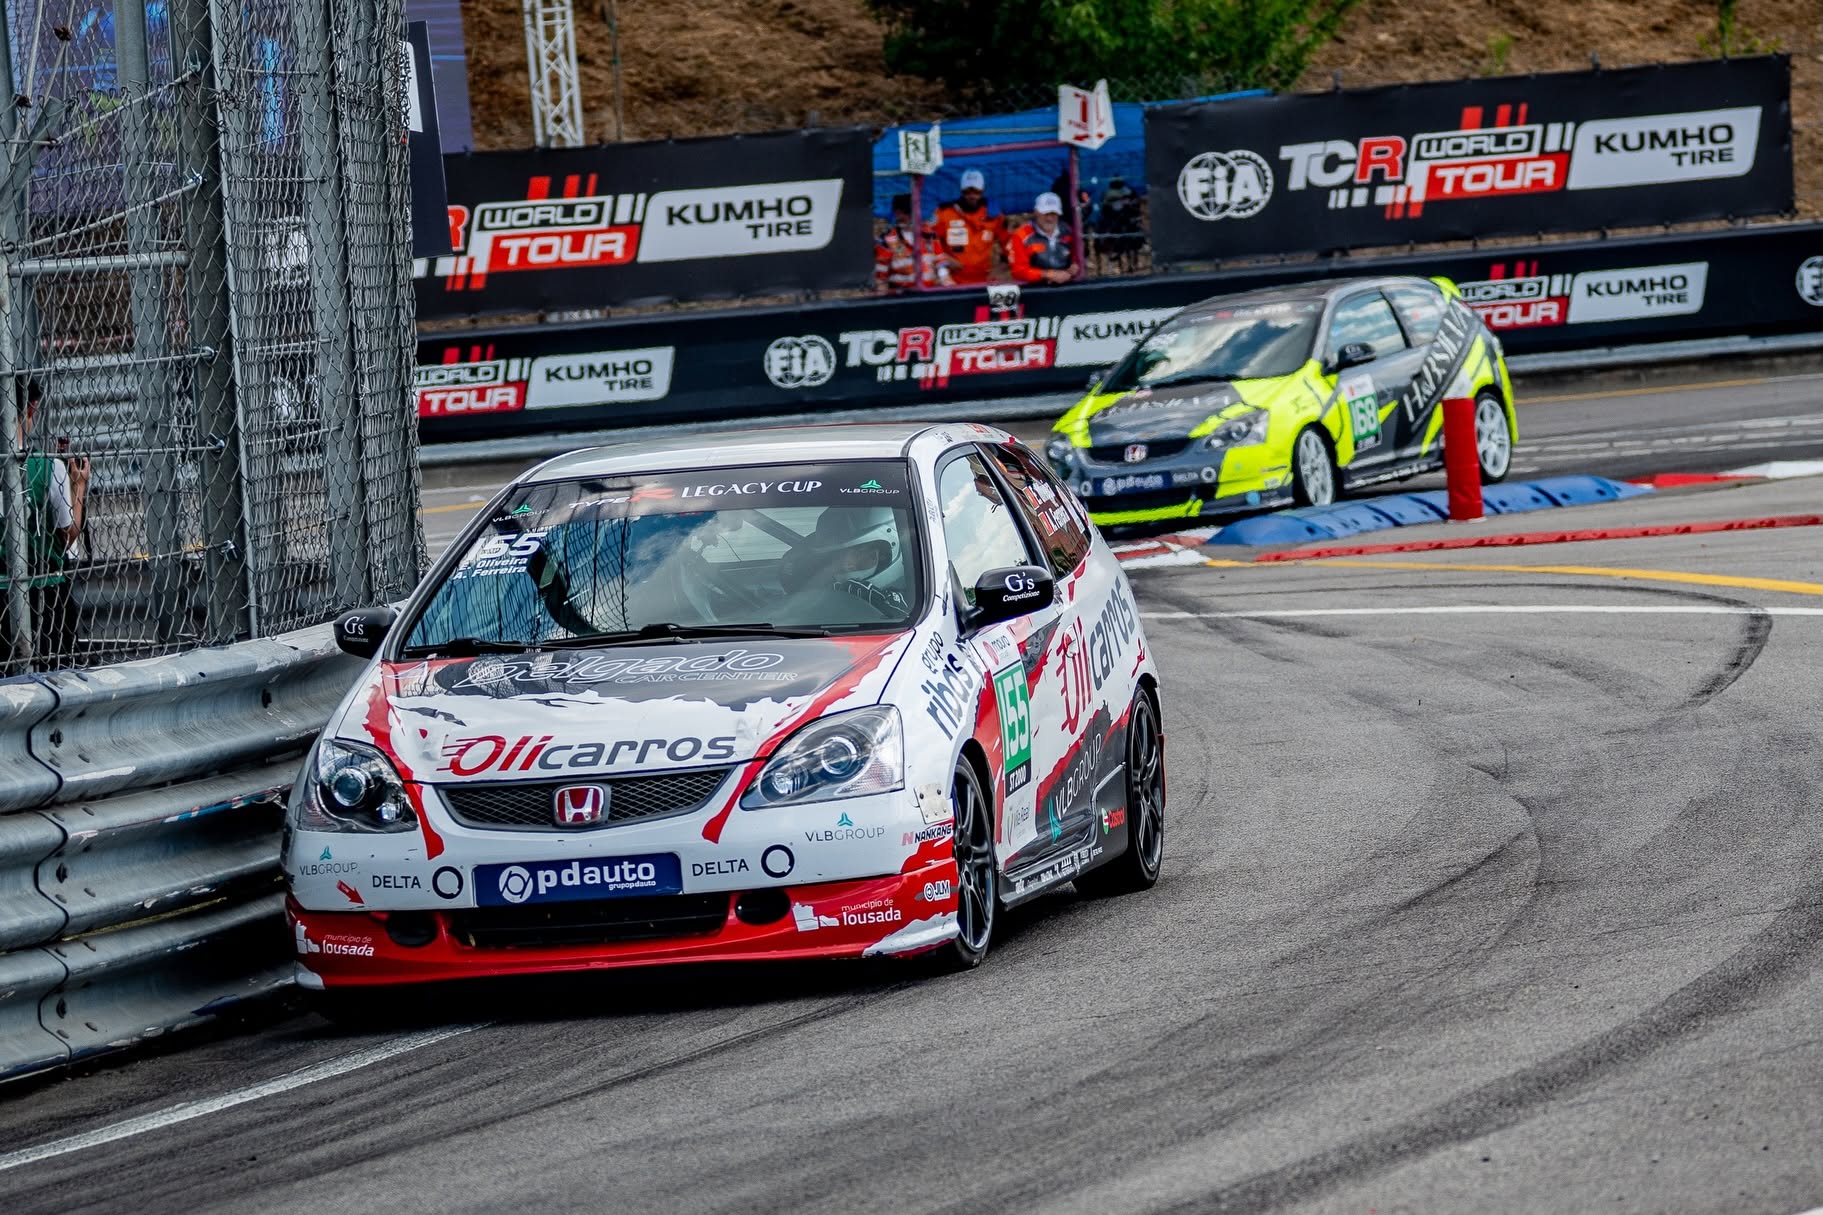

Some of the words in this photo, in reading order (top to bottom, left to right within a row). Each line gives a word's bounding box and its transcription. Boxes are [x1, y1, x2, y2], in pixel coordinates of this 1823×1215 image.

[1420, 130, 1530, 158] WORLD
[1594, 123, 1734, 154] KUMHO
[1279, 136, 1407, 191] TCR
[1671, 147, 1735, 167] TIRE
[1435, 160, 1556, 194] TOUR
[483, 203, 598, 229] WORLD
[666, 195, 813, 226] KUMHO
[745, 219, 813, 239] TIRE
[499, 232, 627, 266] TOUR
[1461, 280, 1540, 301] WORLD
[1586, 274, 1688, 297] KUMHO
[1641, 291, 1688, 306] TIRE
[942, 321, 1028, 346] WORLD
[1073, 317, 1158, 340] KUMH
[838, 326, 935, 368] TCR
[955, 343, 1048, 370] TOUR
[416, 365, 495, 386] WORLD
[545, 359, 653, 383] KUMHO
[604, 377, 653, 391] TIRE
[424, 386, 518, 413] TOUR
[1351, 396, 1379, 437] 168
[569, 496, 630, 509] TYPE
[630, 487, 675, 502] R
[681, 482, 774, 499] LEGACY
[777, 480, 822, 494] CUP
[839, 487, 900, 495] VLBGROUP
[492, 508, 550, 523] VLBGROUP
[453, 571, 467, 580] A.
[471, 565, 527, 577] Ferreira
[476, 557, 528, 568] Oliveira
[1004, 571, 1035, 592] G's
[1003, 590, 1040, 602] Competizione
[922, 631, 944, 674] grupo
[921, 653, 974, 741] ribas
[998, 670, 1029, 761] 155
[442, 735, 737, 776] Olicarros
[1055, 732, 1101, 821] VLBGROUP
[805, 826, 885, 842] VLBGROUP
[914, 824, 952, 843] NANKANG
[300, 862, 359, 876] VLBGROUP
[537, 861, 656, 894] pdauto
[691, 859, 750, 877] DELTA
[372, 875, 421, 889] DELTA
[608, 880, 657, 891] grupopdauto
[884, 898, 894, 906] de
[842, 907, 902, 926] lousada
[322, 939, 375, 957] lousada
[361, 935, 372, 944] de
